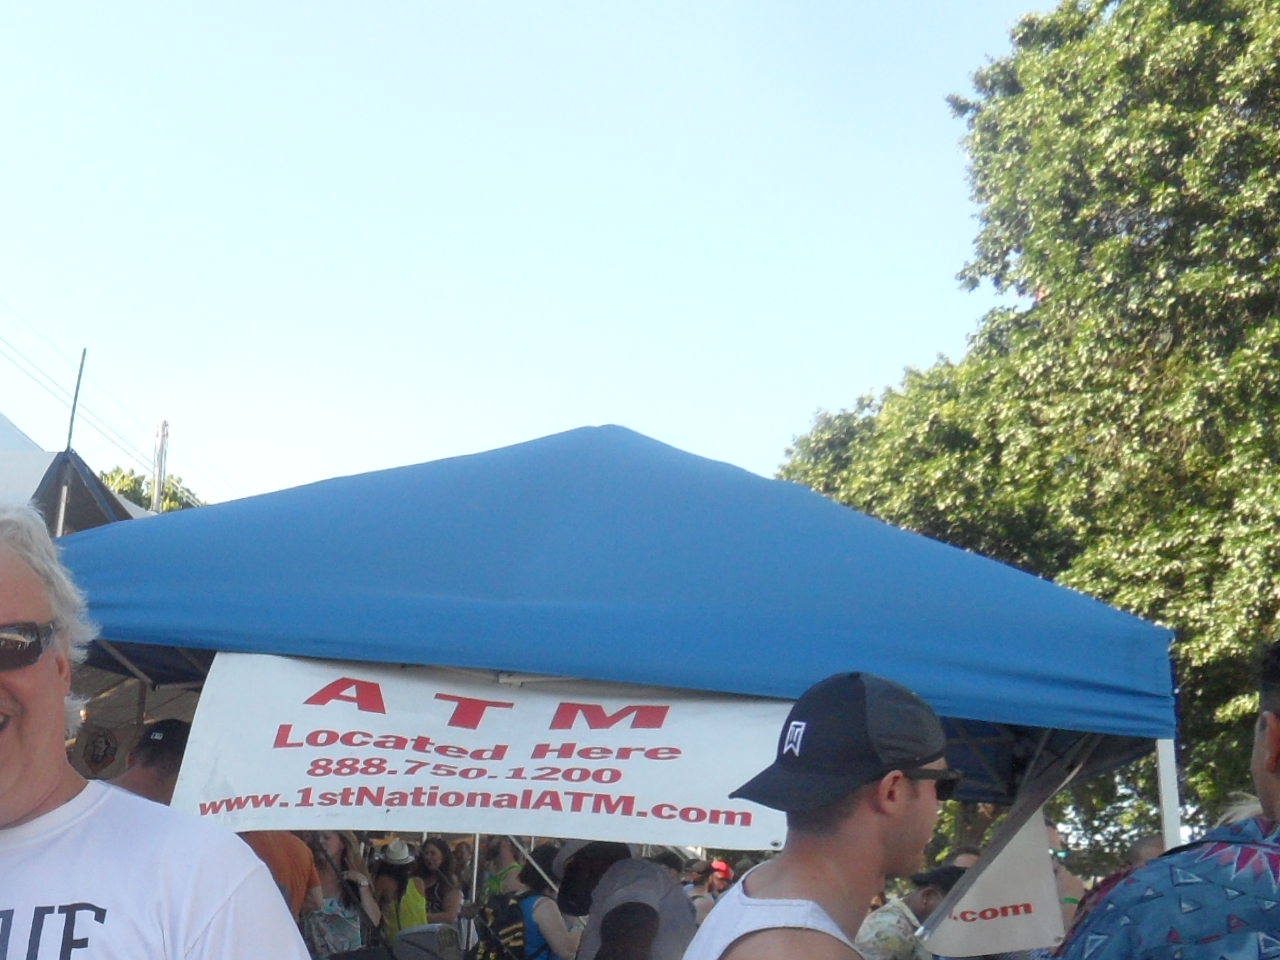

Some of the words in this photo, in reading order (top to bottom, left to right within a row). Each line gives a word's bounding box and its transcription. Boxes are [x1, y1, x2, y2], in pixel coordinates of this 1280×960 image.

[273, 724, 508, 760] Located
[531, 743, 682, 760] Here
[306, 757, 622, 784] 888.750.1200
[199, 786, 752, 826] www.1stNationalATM.com
[948, 903, 1033, 923] .com
